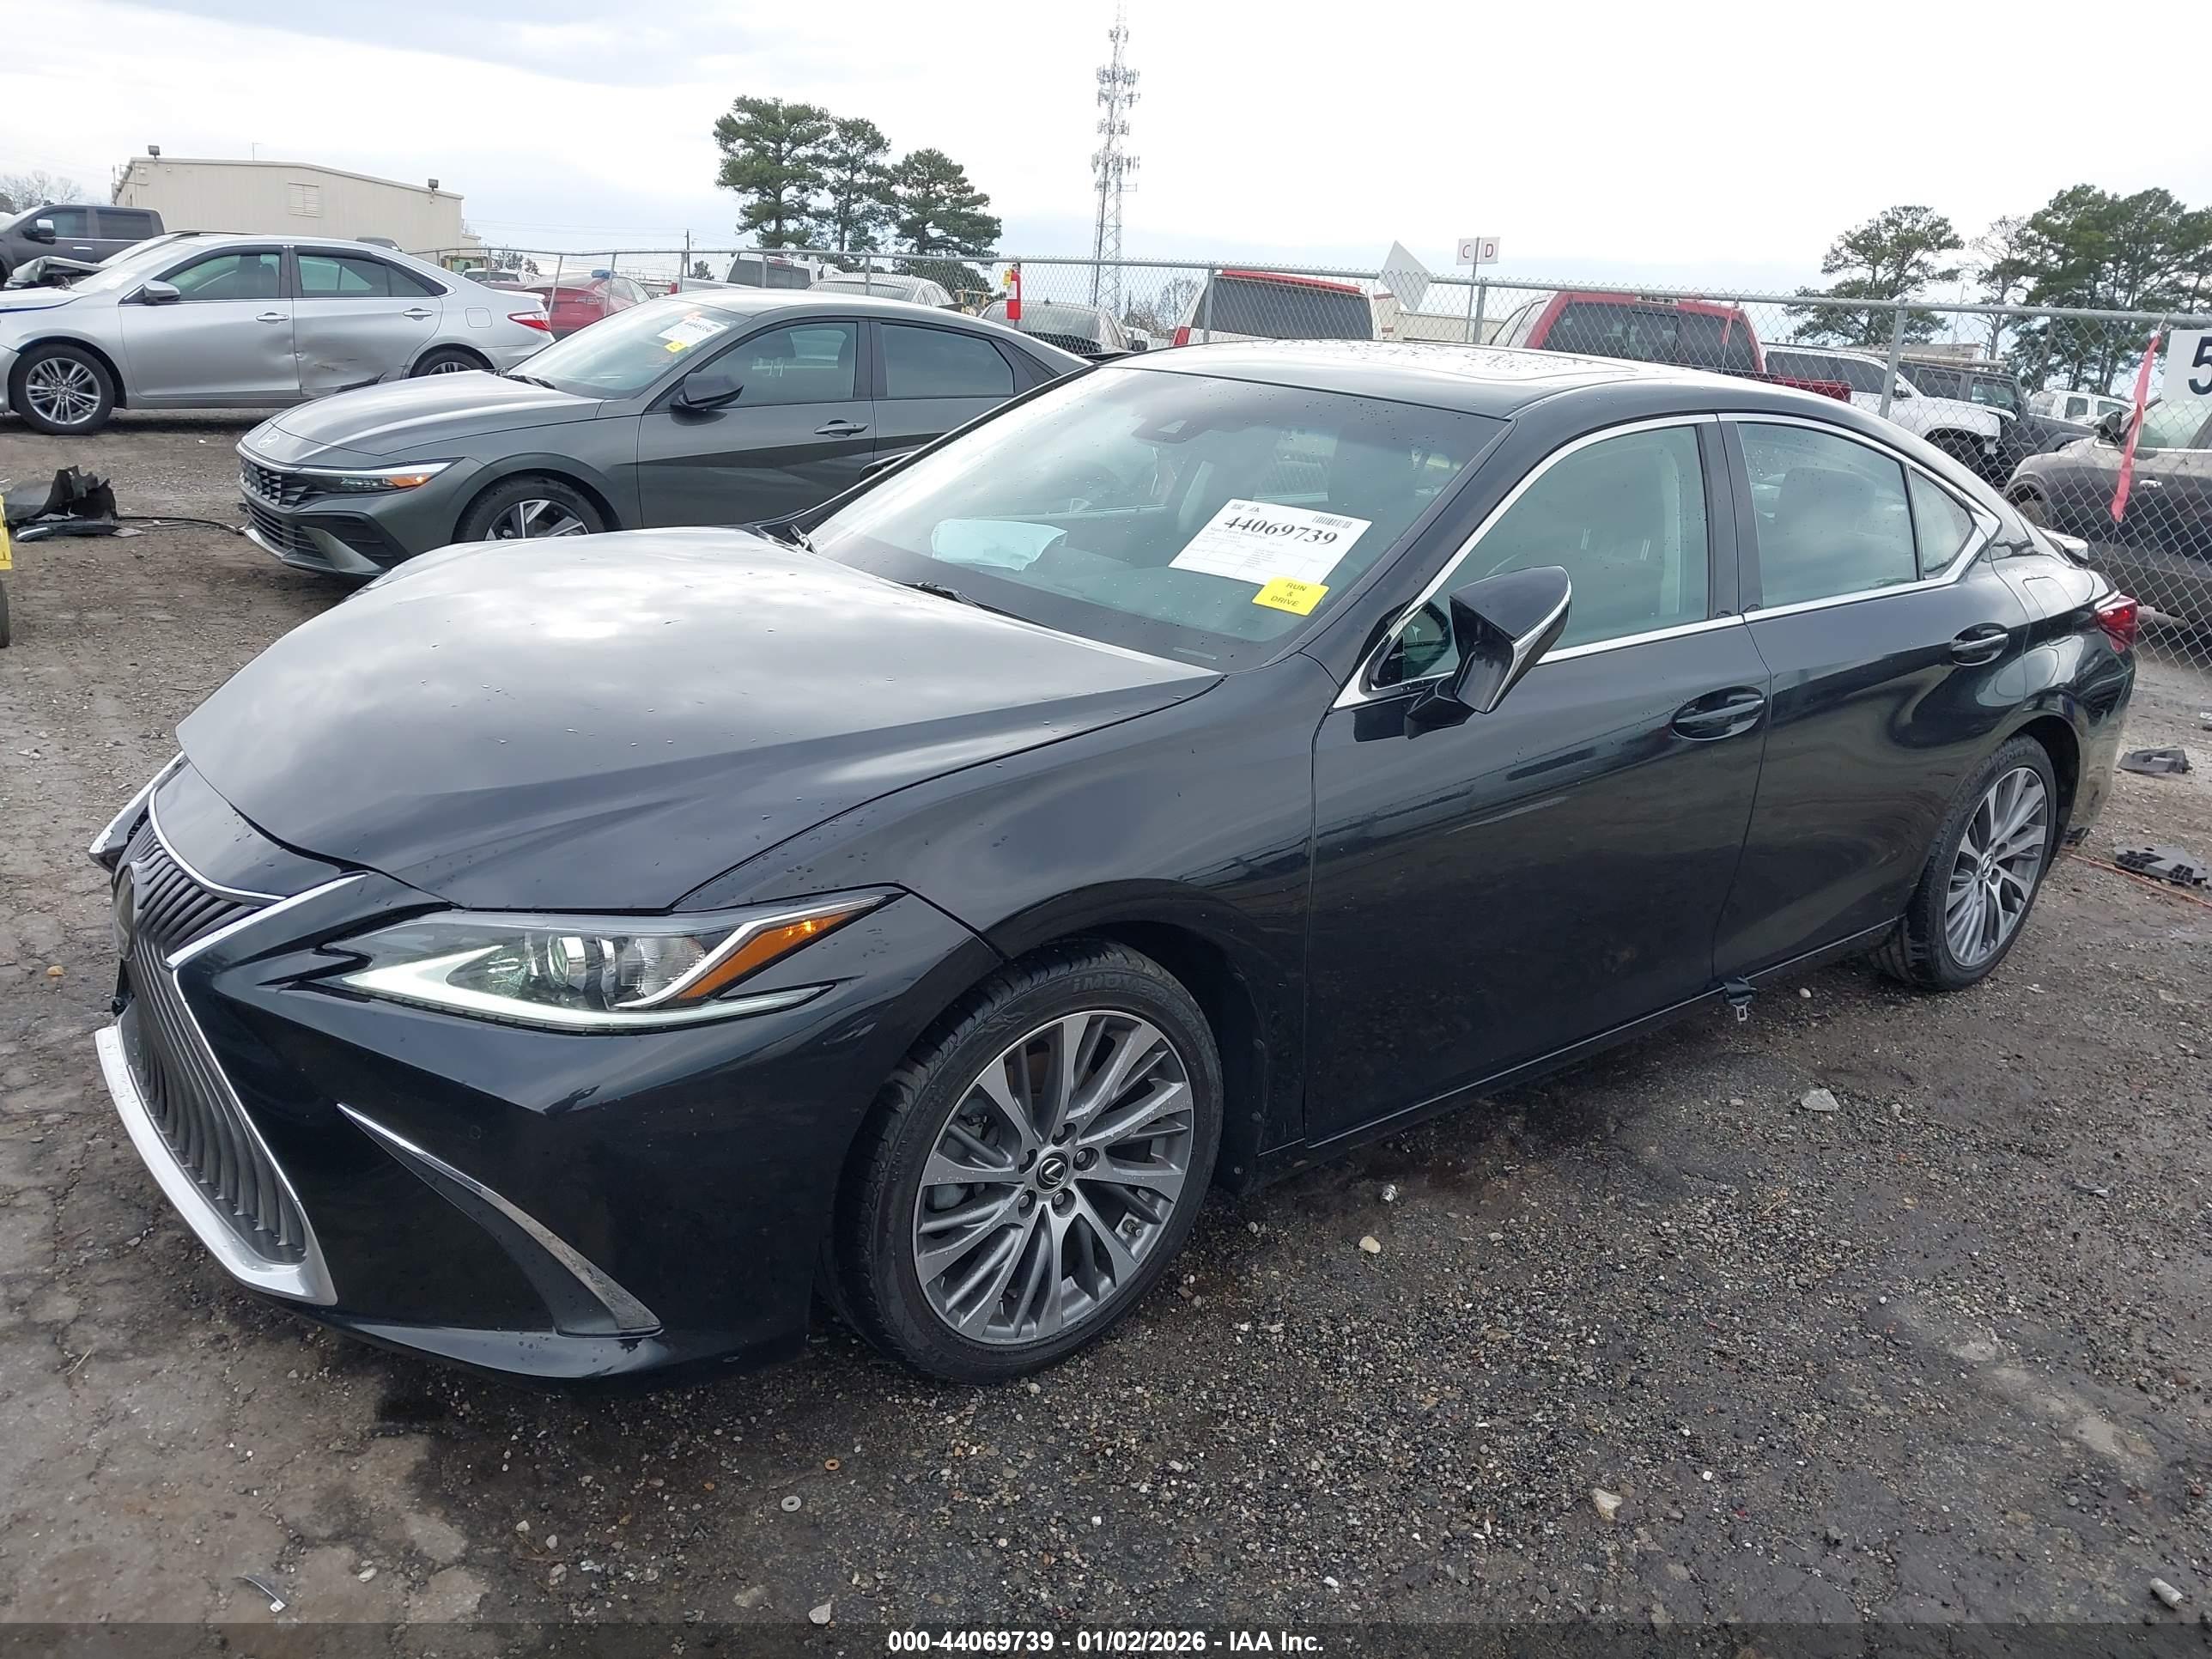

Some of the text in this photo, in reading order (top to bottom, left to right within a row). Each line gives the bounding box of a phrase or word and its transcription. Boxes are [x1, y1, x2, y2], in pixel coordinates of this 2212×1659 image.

[1462, 243, 1493, 258] C D
[1224, 515, 1338, 545] 44069739
[1285, 582, 1308, 592] RUN
[1270, 595, 1300, 607] DRIVE
